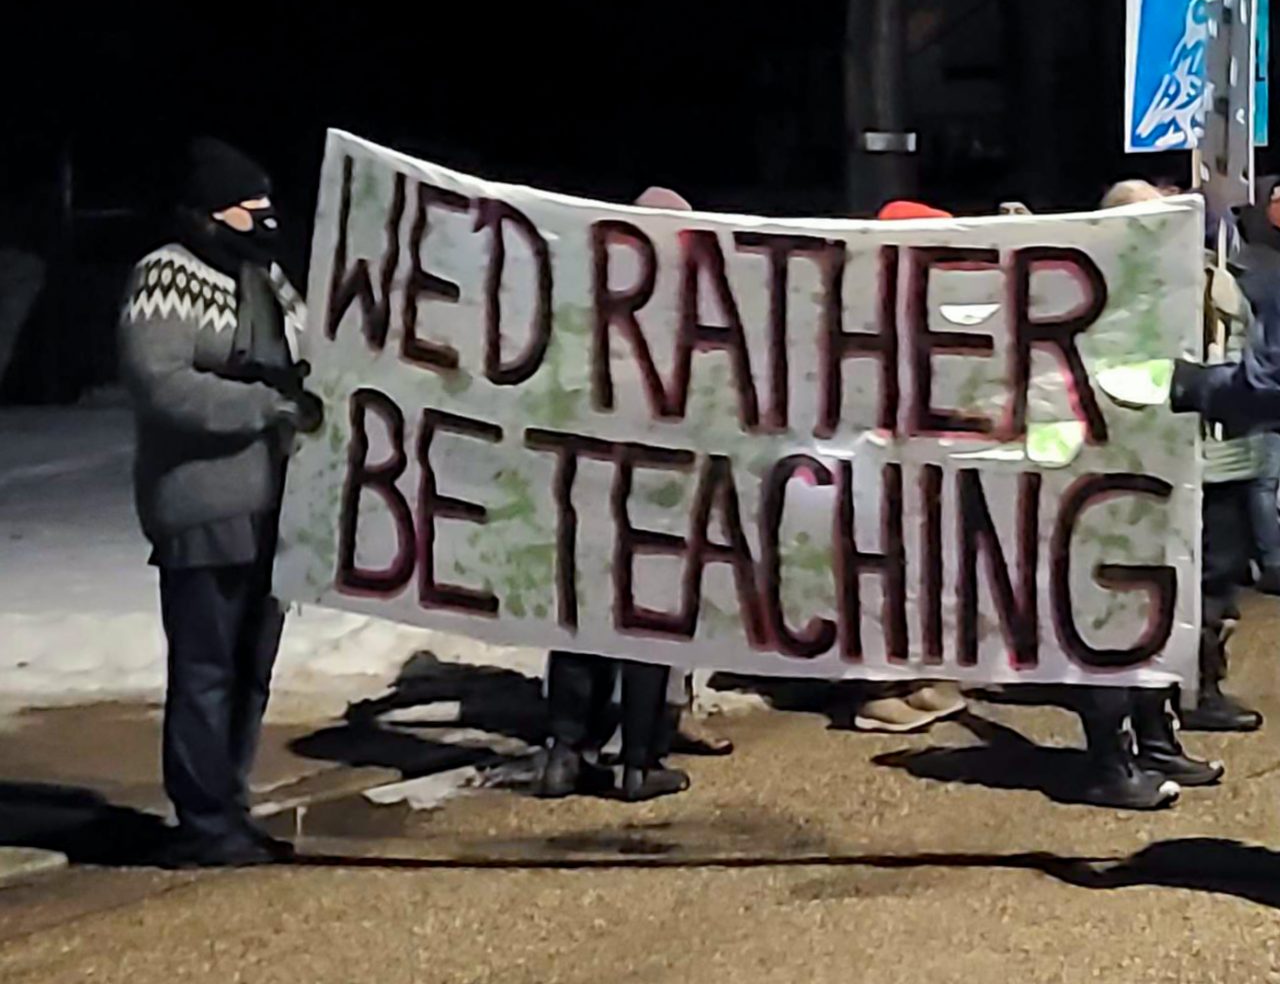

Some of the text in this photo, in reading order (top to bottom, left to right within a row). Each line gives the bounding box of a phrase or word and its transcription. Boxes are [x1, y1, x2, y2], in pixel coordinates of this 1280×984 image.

[590, 219, 1108, 445] RATHER
[334, 387, 1179, 671] BE TEACHING
